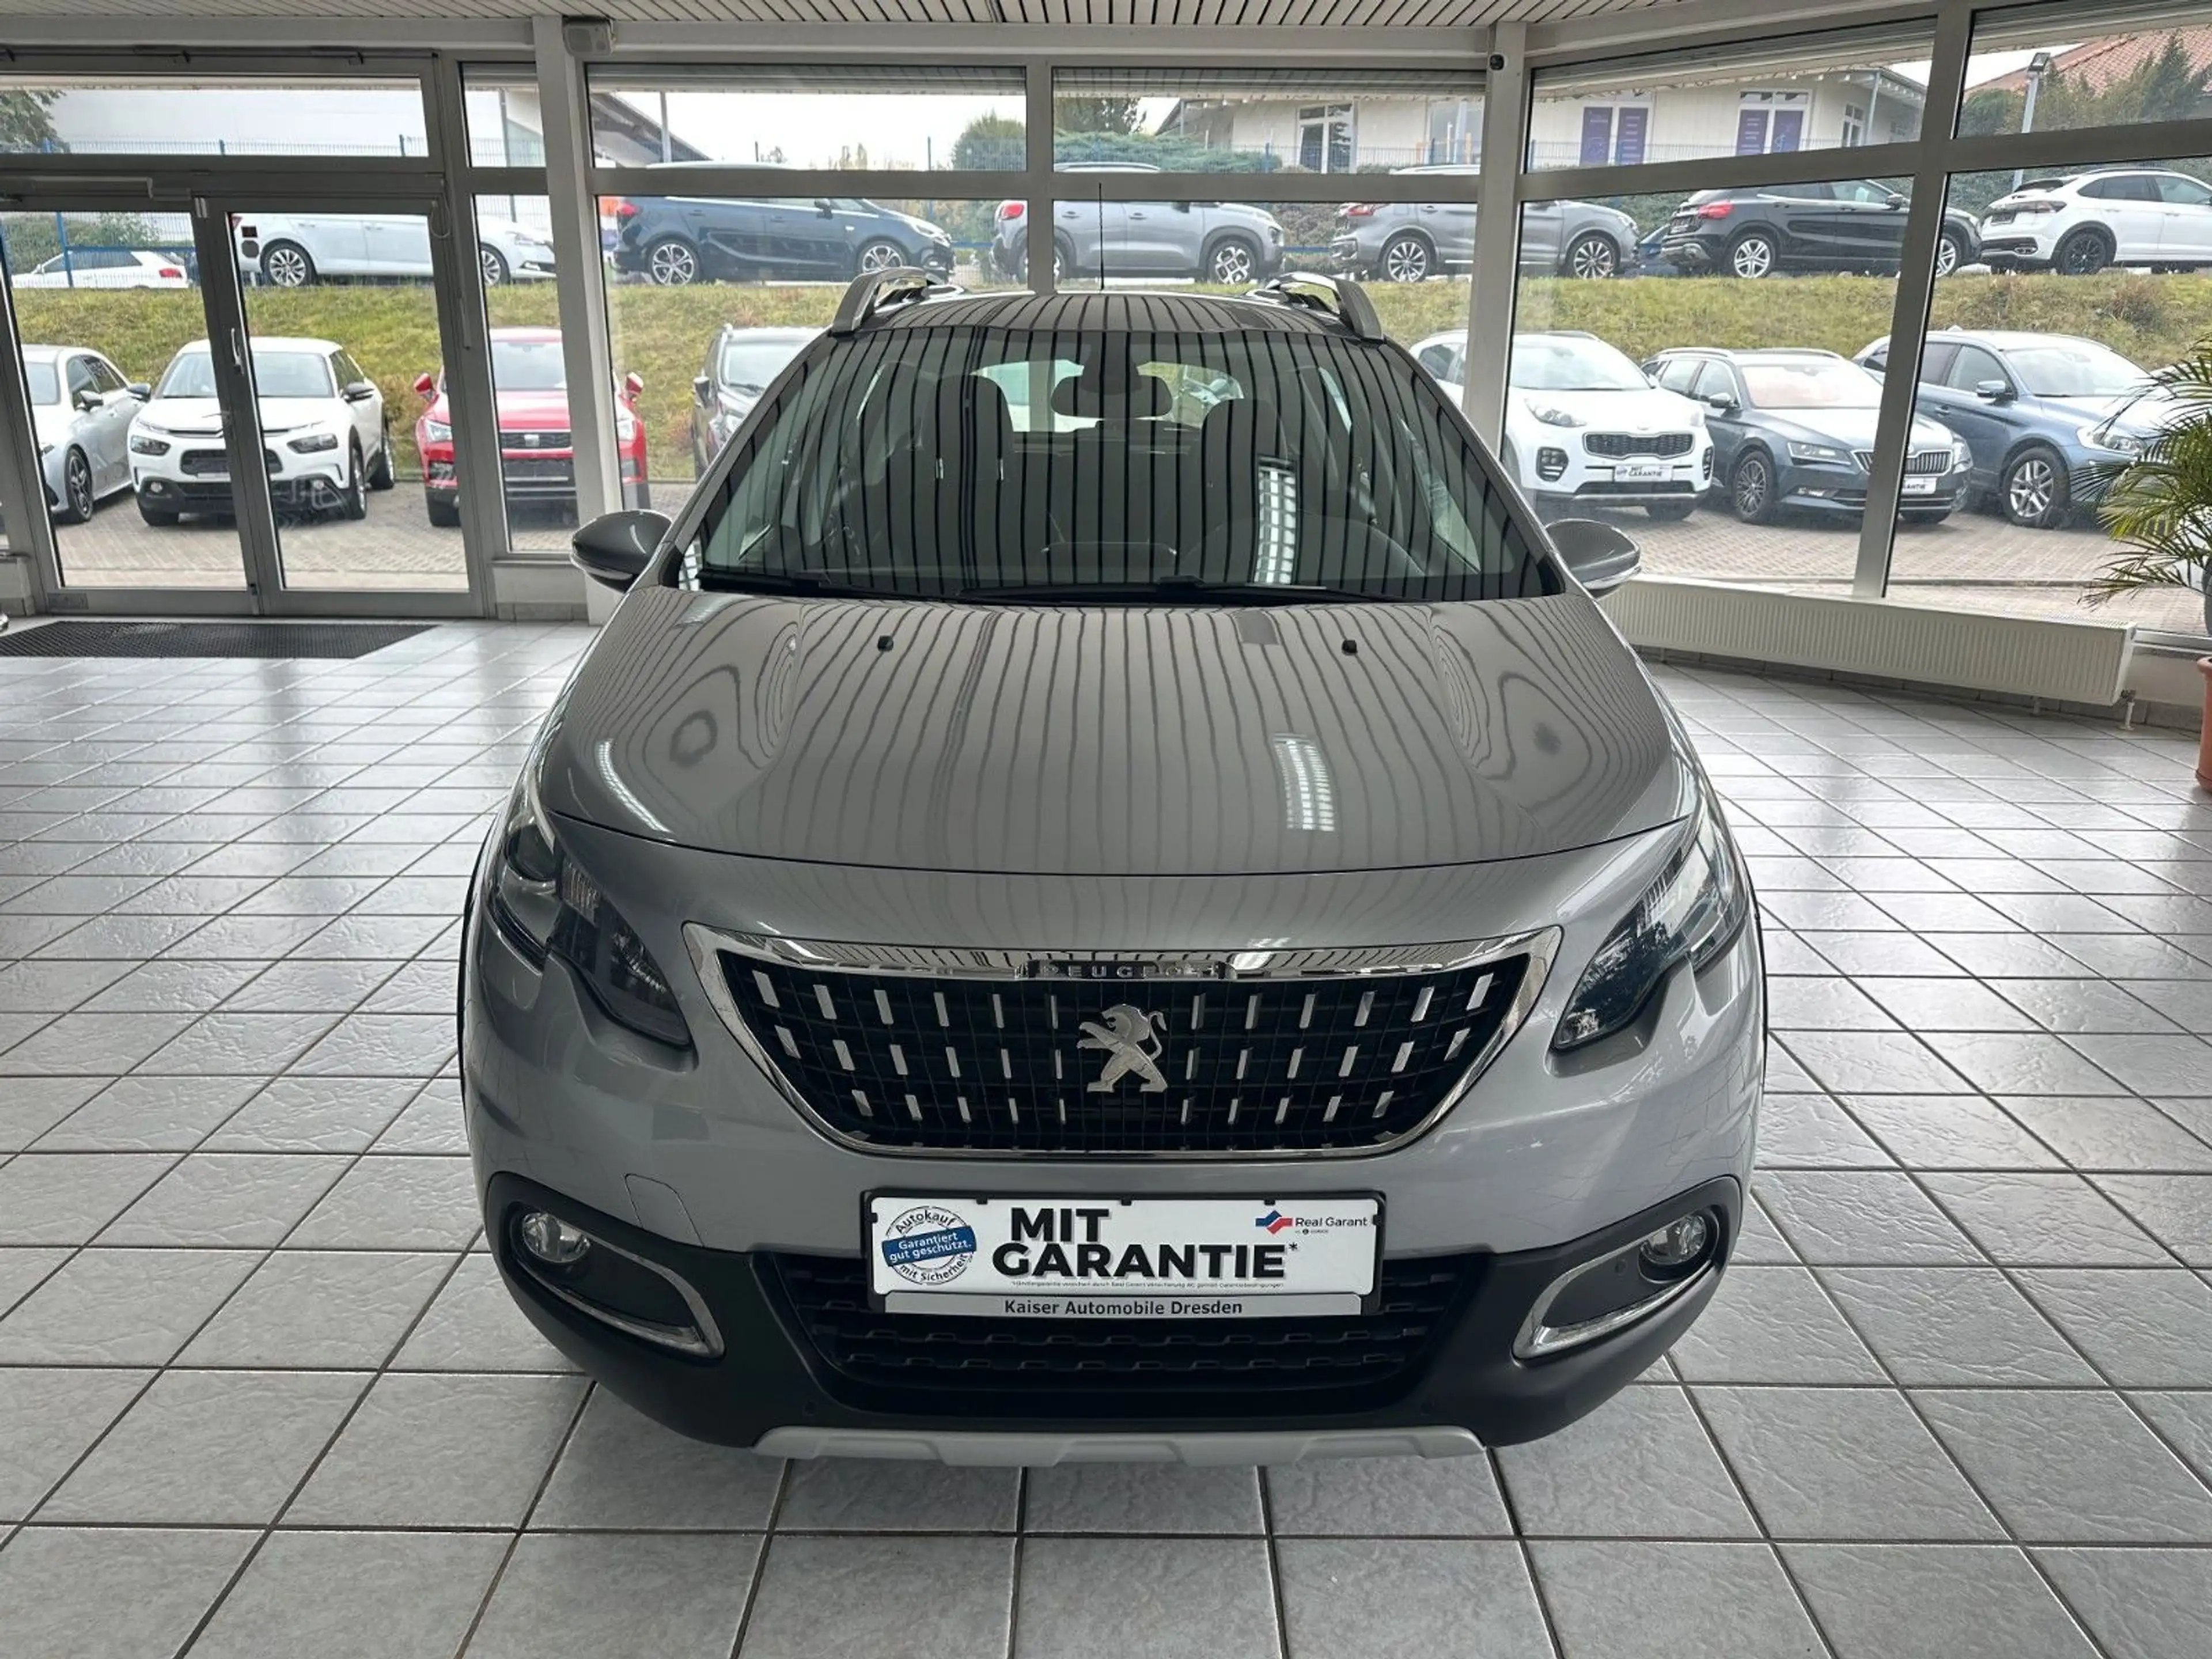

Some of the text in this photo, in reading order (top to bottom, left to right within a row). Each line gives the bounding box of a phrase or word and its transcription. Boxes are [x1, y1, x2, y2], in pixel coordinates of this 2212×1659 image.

[895, 1209, 957, 1234] Autokauf
[1011, 1207, 1110, 1242] MIT
[1296, 1216, 1368, 1227] Real Garant
[898, 1232, 959, 1250] Garantiert
[889, 1251, 911, 1263] gut
[900, 1252, 971, 1281] mit Sicherheit
[1004, 1300, 1243, 1315] Kaiser Automobile Dresden
